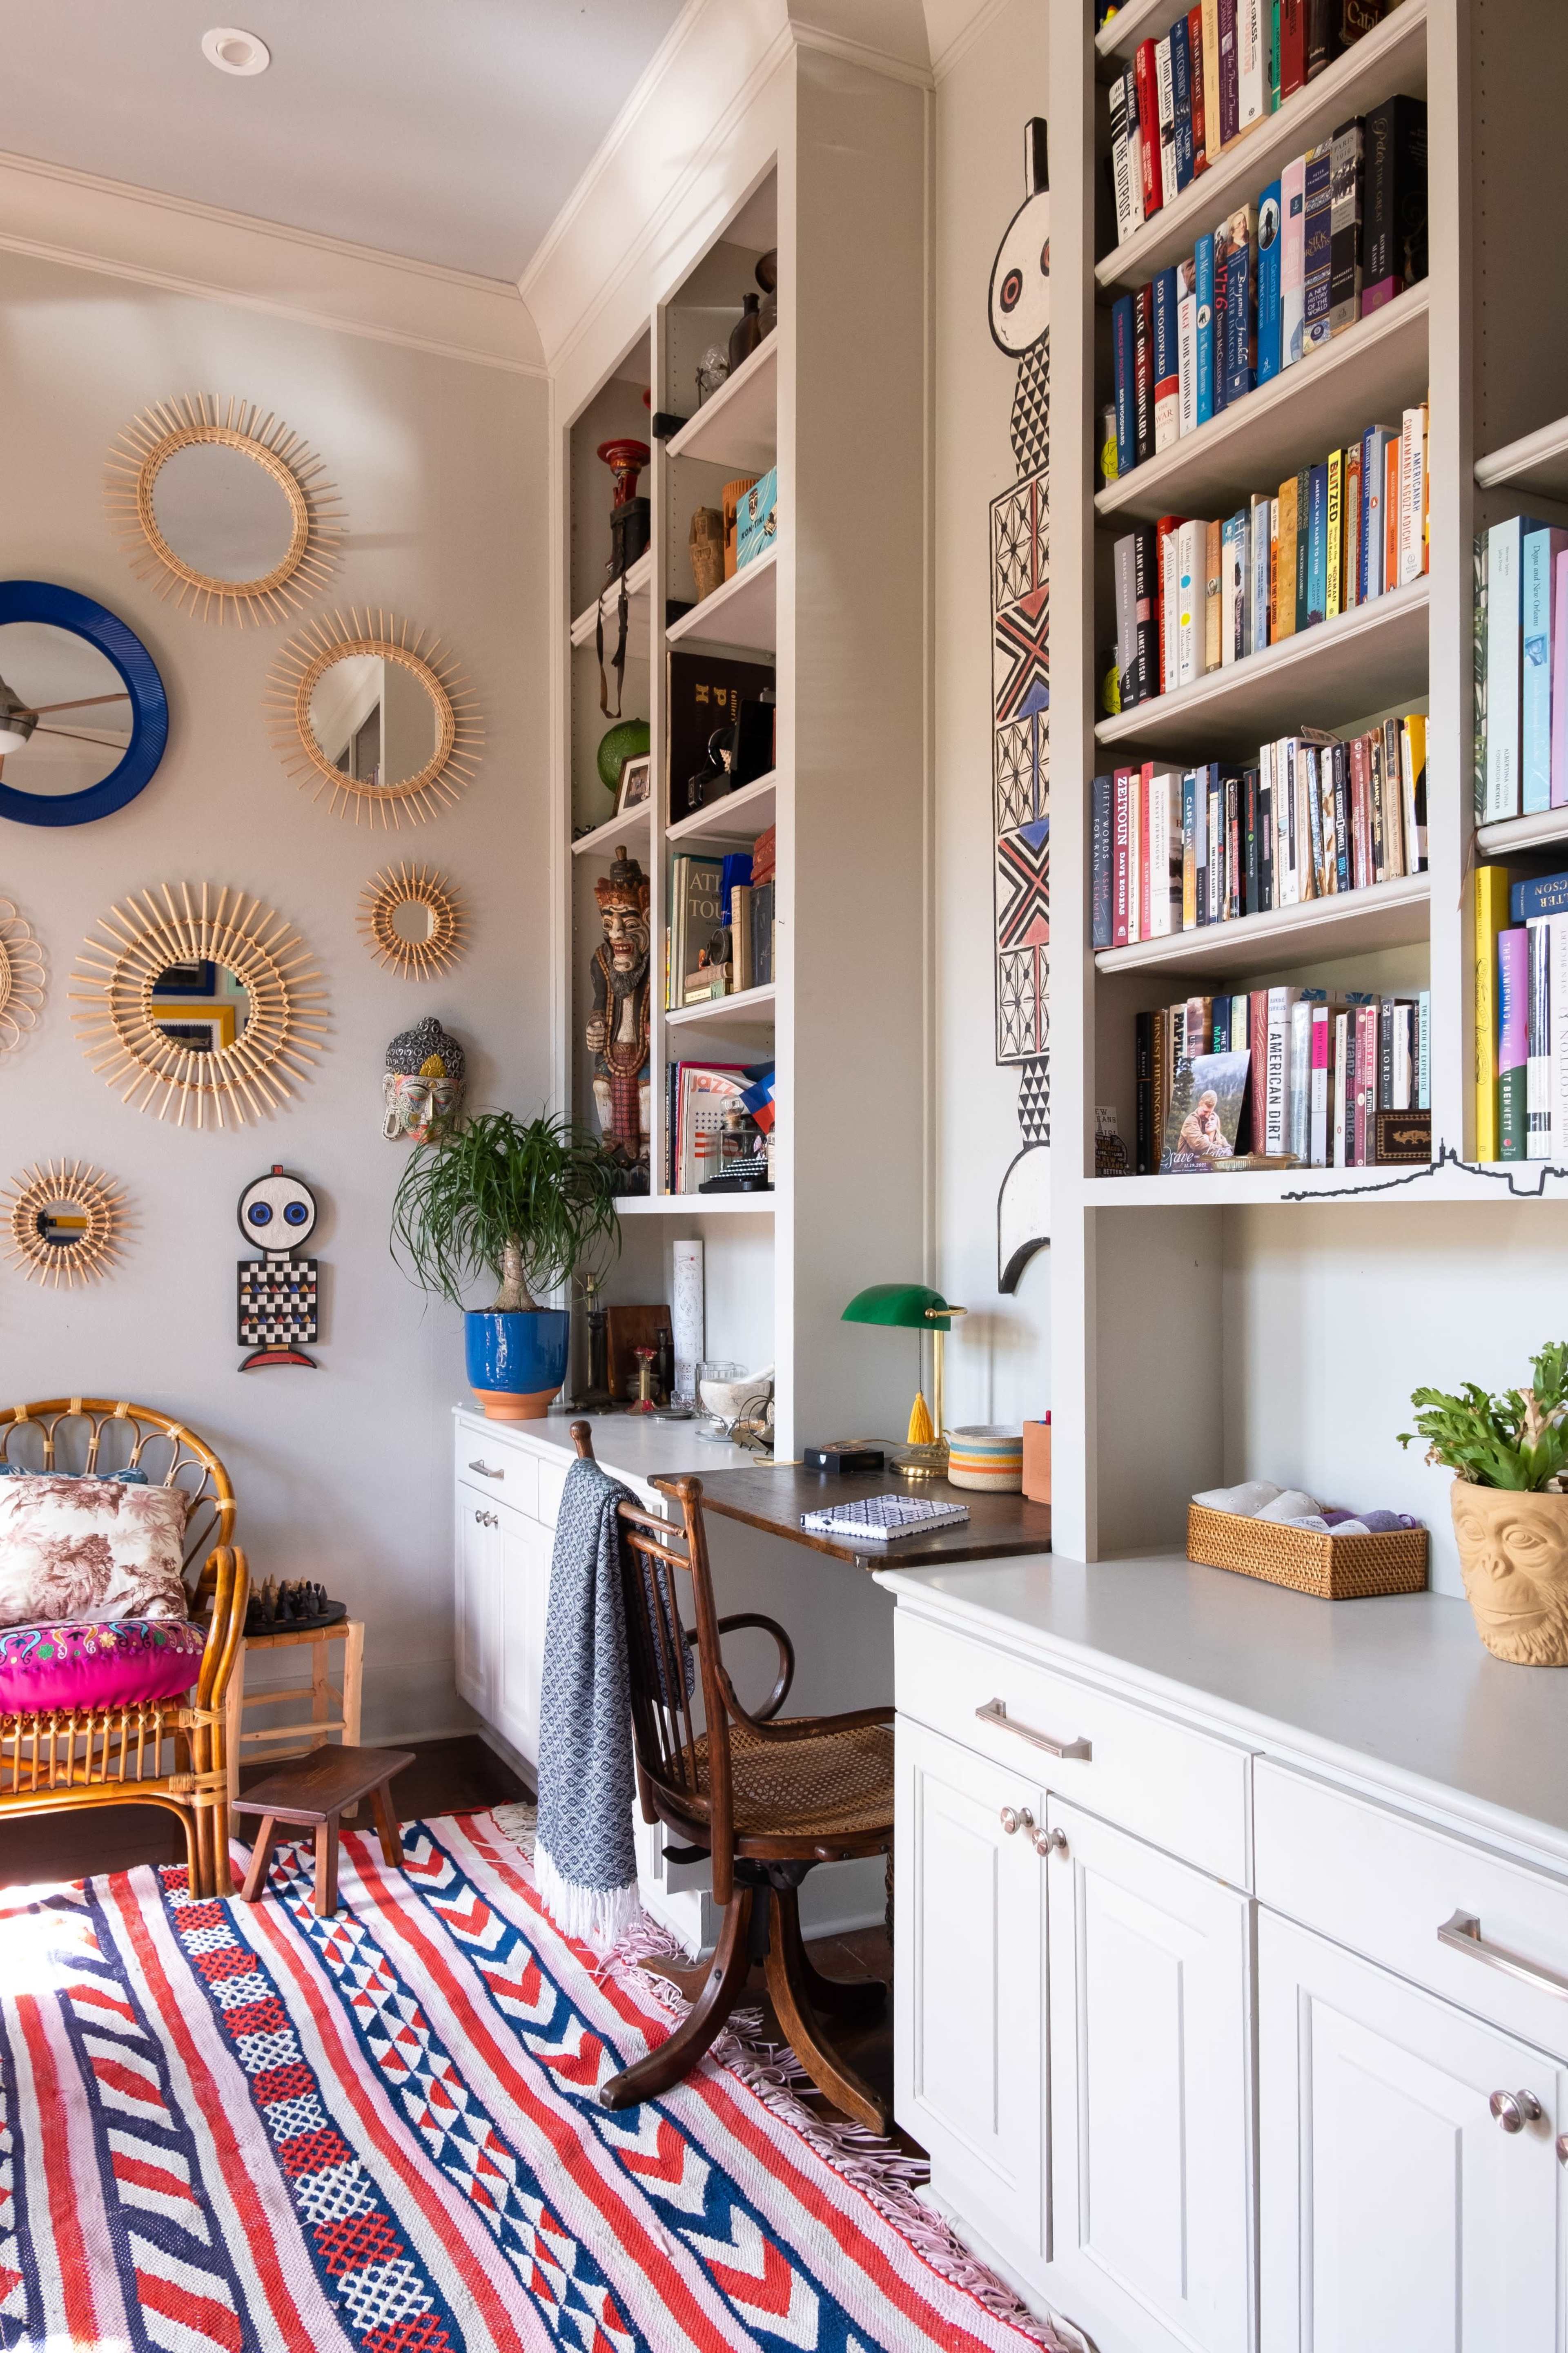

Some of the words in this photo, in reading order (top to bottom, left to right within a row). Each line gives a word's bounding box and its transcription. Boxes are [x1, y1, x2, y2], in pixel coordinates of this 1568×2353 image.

[1163, 58, 1171, 82] Tom
[1176, 59, 1186, 98] CONROY
[1163, 81, 1173, 120] Clancy
[1116, 136, 1127, 167] THE
[1334, 136, 1353, 153] PARIS
[1118, 164, 1130, 223] OUTPOST
[1305, 237, 1330, 257] ROADS
[1309, 231, 1327, 247] SILK
[1215, 264, 1228, 310] 1776
[1234, 260, 1247, 317] Benjamin
[1307, 292, 1328, 305] HISTORY
[1314, 284, 1327, 296] NEW
[1307, 303, 1327, 317] WORLD
[1318, 297, 1328, 308] THE
[1137, 337, 1145, 366] BOB
[1235, 318, 1248, 365] Franklin
[1138, 366, 1147, 439] WOODWARD
[1156, 409, 1174, 421] WAR
[1403, 418, 1412, 481] CHIMAMANDA
[1329, 459, 1339, 523] BLITZED
[1412, 452, 1421, 512] AMERICANAH
[1403, 483, 1412, 512] NGOZI
[741, 513, 764, 541] KON-TIKI
[1234, 516, 1245, 560] Hide
[1402, 515, 1412, 551] ADICHIE
[1167, 551, 1175, 583] blink
[1314, 548, 1319, 557] TO
[1532, 544, 1541, 568] Degas
[1185, 565, 1191, 573] to
[1532, 568, 1541, 582] and
[1532, 583, 1541, 599] New
[1532, 600, 1541, 627] Orleans
[1118, 776, 1127, 845] ZEITOUN
[1145, 806, 1149, 815] TO
[1336, 819, 1345, 854] ORWELL
[1503, 941, 1511, 961] THE
[1503, 964, 1511, 1019] VANISHING
[1421, 1044, 1427, 1052] OF
[1503, 1024, 1512, 1048] HALF
[1269, 1033, 1282, 1104] AMERICAN
[1347, 1035, 1356, 1077] franz
[1367, 1055, 1372, 1064] AT
[1559, 1029, 1568, 1098] COTTON
[690, 1075, 735, 1096] jazz
[1503, 1086, 1512, 1131] BENNETT
[1268, 1111, 1281, 1142] DIRT
[1160, 1146, 1194, 1169] Save
